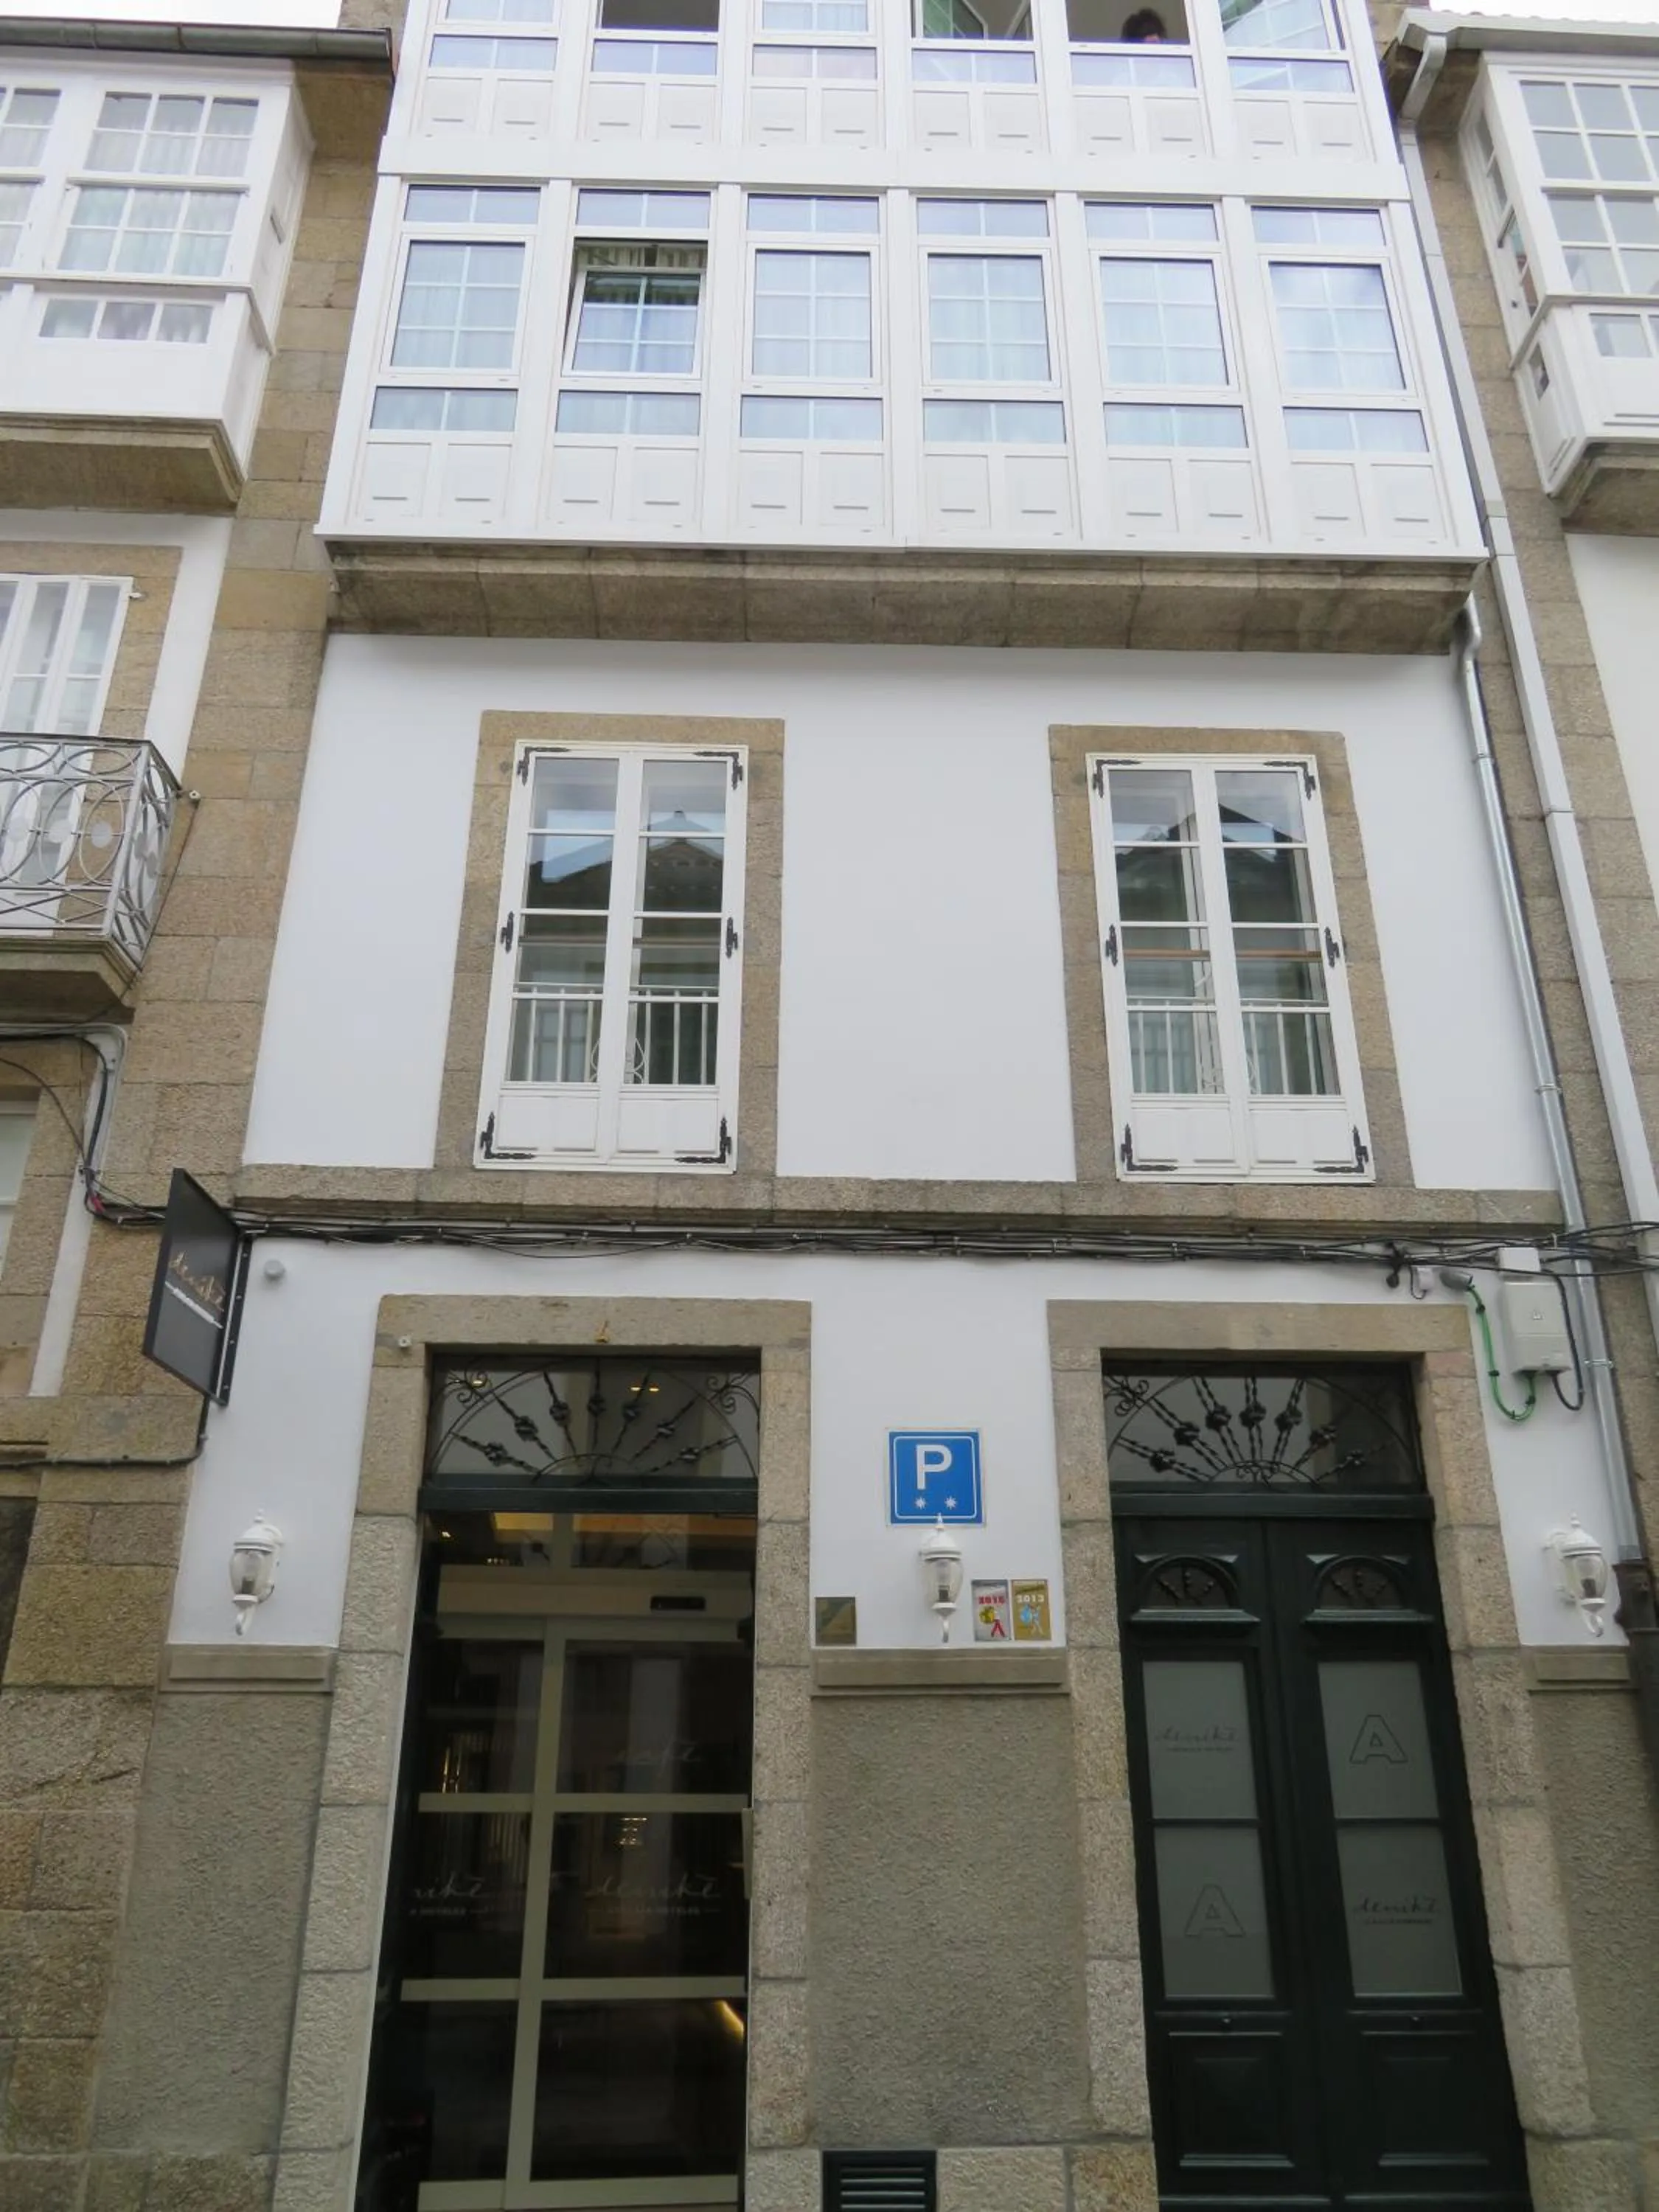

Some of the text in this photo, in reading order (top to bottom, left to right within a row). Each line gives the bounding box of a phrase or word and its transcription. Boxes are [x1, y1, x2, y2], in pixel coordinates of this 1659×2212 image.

[916, 1444, 953, 1489] P
[1349, 1714, 1408, 1764] A
[1184, 1884, 1246, 1938] A
